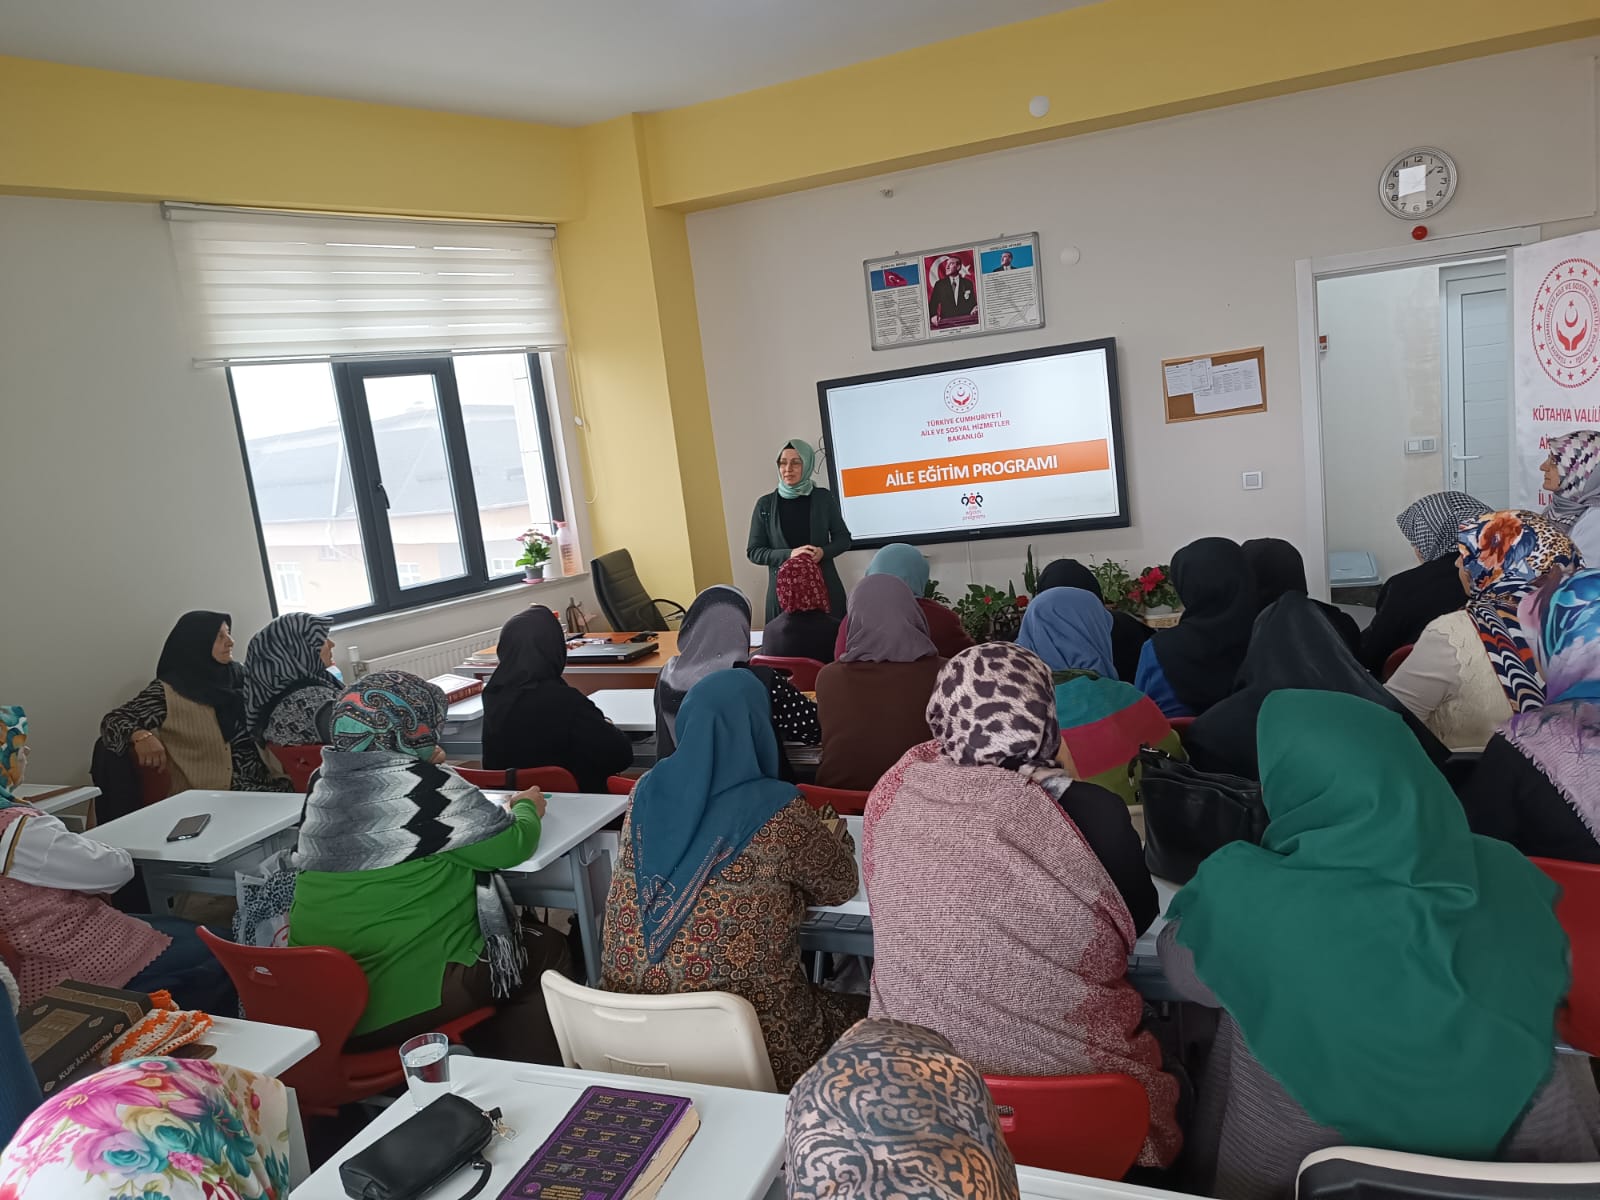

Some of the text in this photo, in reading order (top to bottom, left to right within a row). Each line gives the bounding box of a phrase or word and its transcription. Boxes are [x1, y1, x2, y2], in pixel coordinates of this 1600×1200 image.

[927, 411, 1002, 427] TÜRKİYE CUMHURİYETİ
[1532, 405, 1572, 421] KÜTAHYA
[921, 428, 934, 436] AİLE
[945, 426, 970, 434] SOSYAL
[972, 420, 1010, 430] HİZMETLER
[947, 432, 984, 442] BAKANLIĞI
[886, 455, 1058, 487] AİLE EĞİTİM PROGRAMI
[1538, 490, 1546, 505] İL
